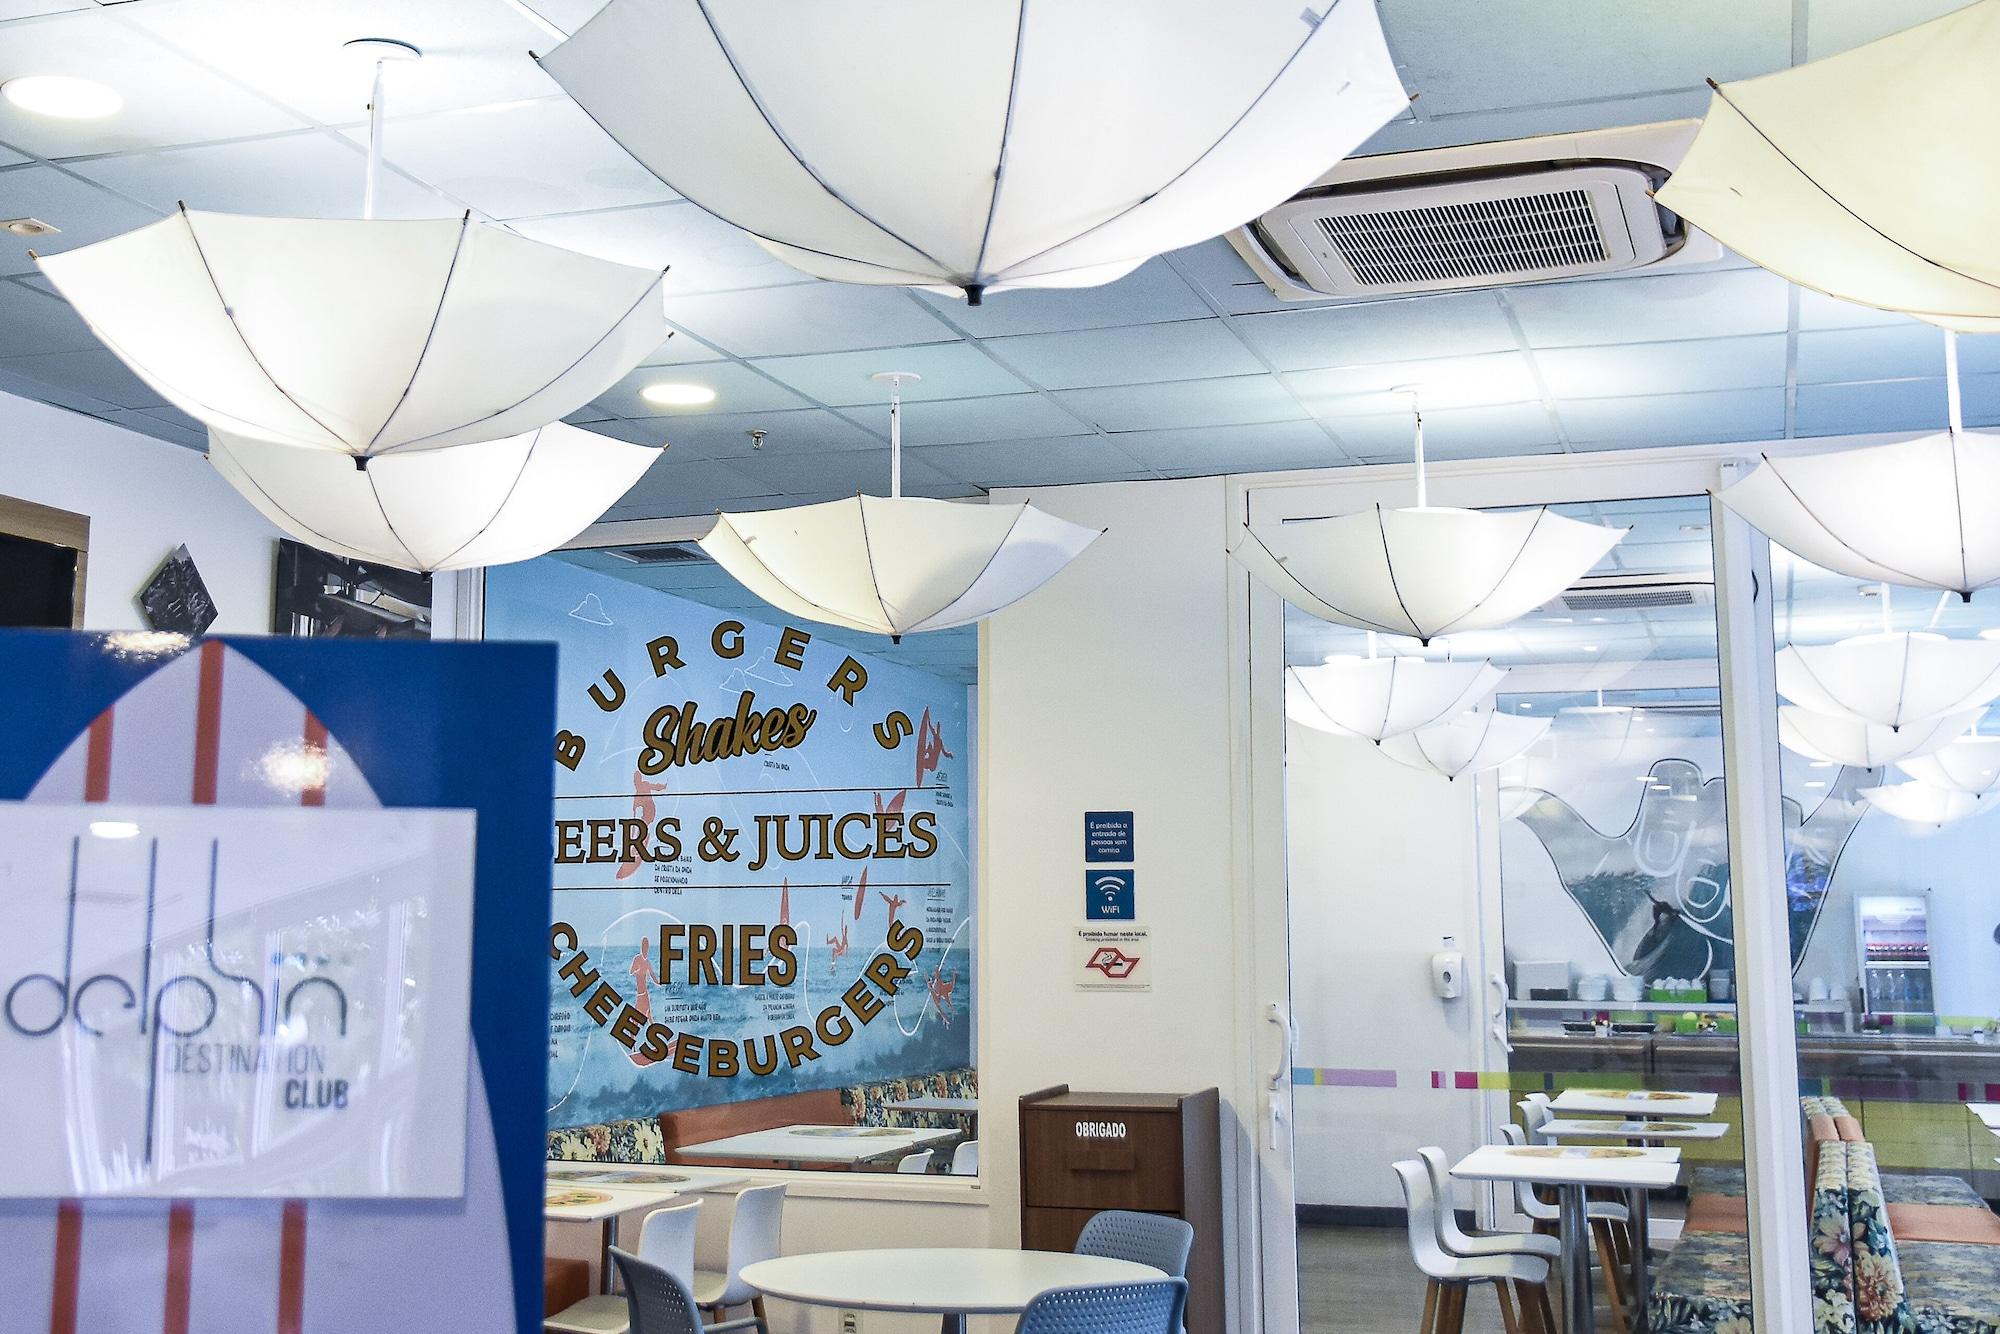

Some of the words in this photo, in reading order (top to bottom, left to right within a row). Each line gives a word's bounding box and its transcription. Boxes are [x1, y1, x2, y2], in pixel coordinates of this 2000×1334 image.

[553, 620, 914, 772] BURGERS
[637, 690, 817, 776] Shakes
[698, 816, 740, 864] &
[748, 811, 939, 872] JUICES
[659, 924, 798, 986] FRIES
[551, 919, 924, 1079] CHEESEBURGERS
[285, 1078, 349, 1109] CLUB
[1075, 1121, 1127, 1138] OBRIGADO
